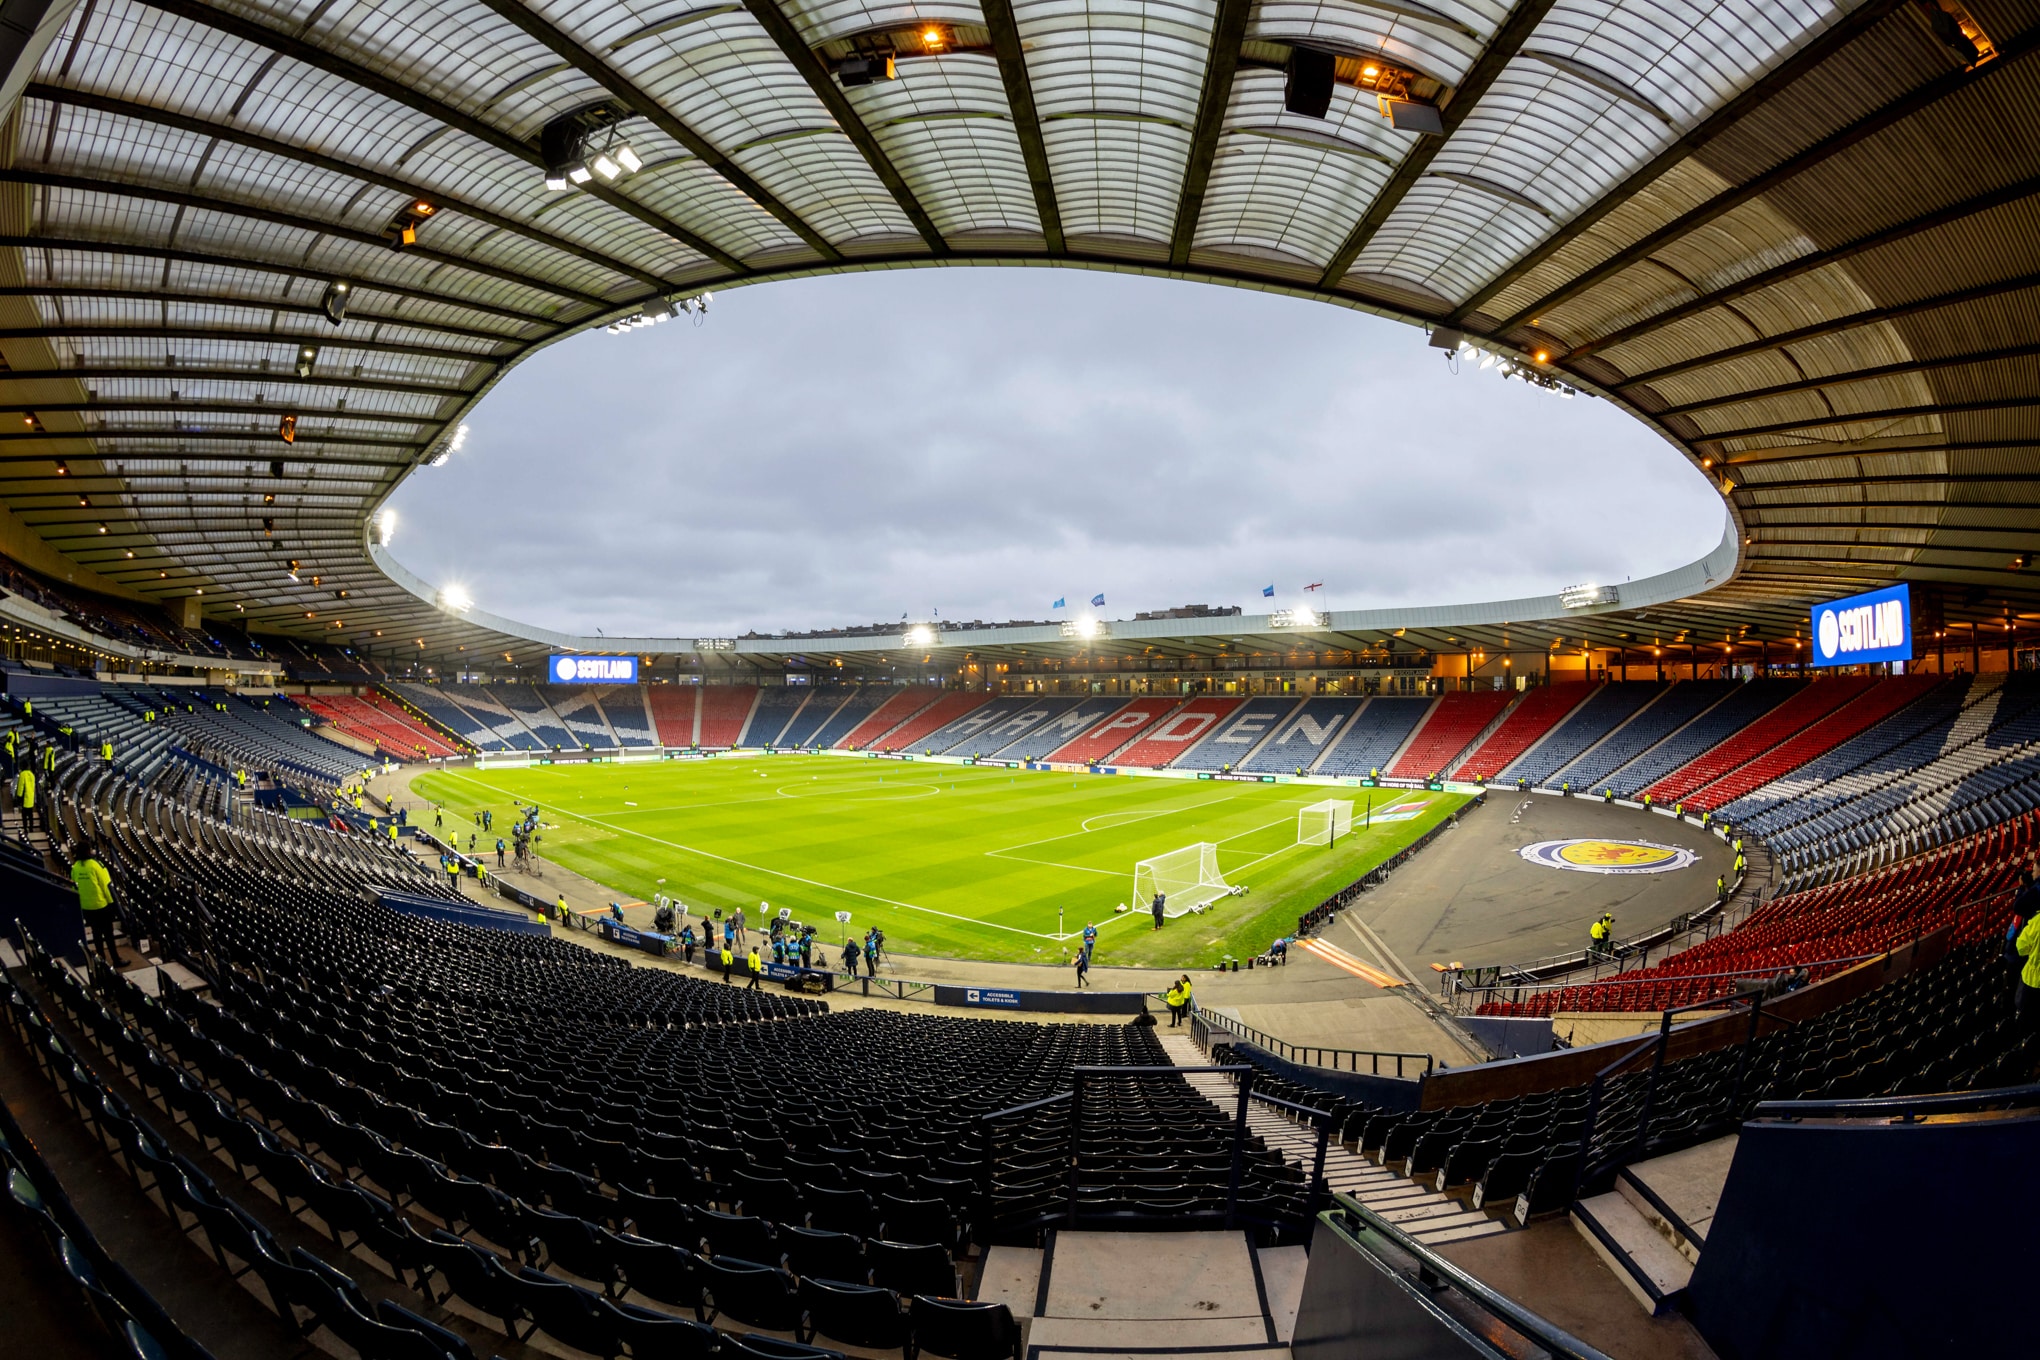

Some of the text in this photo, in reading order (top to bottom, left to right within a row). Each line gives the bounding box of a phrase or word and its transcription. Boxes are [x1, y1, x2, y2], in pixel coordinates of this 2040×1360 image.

[1838, 600, 1904, 653] SCOTLAND
[577, 659, 632, 680] SCOTLAND
[946, 710, 1343, 746] HAMPDEN
[1518, 1204, 1526, 1216] GG
